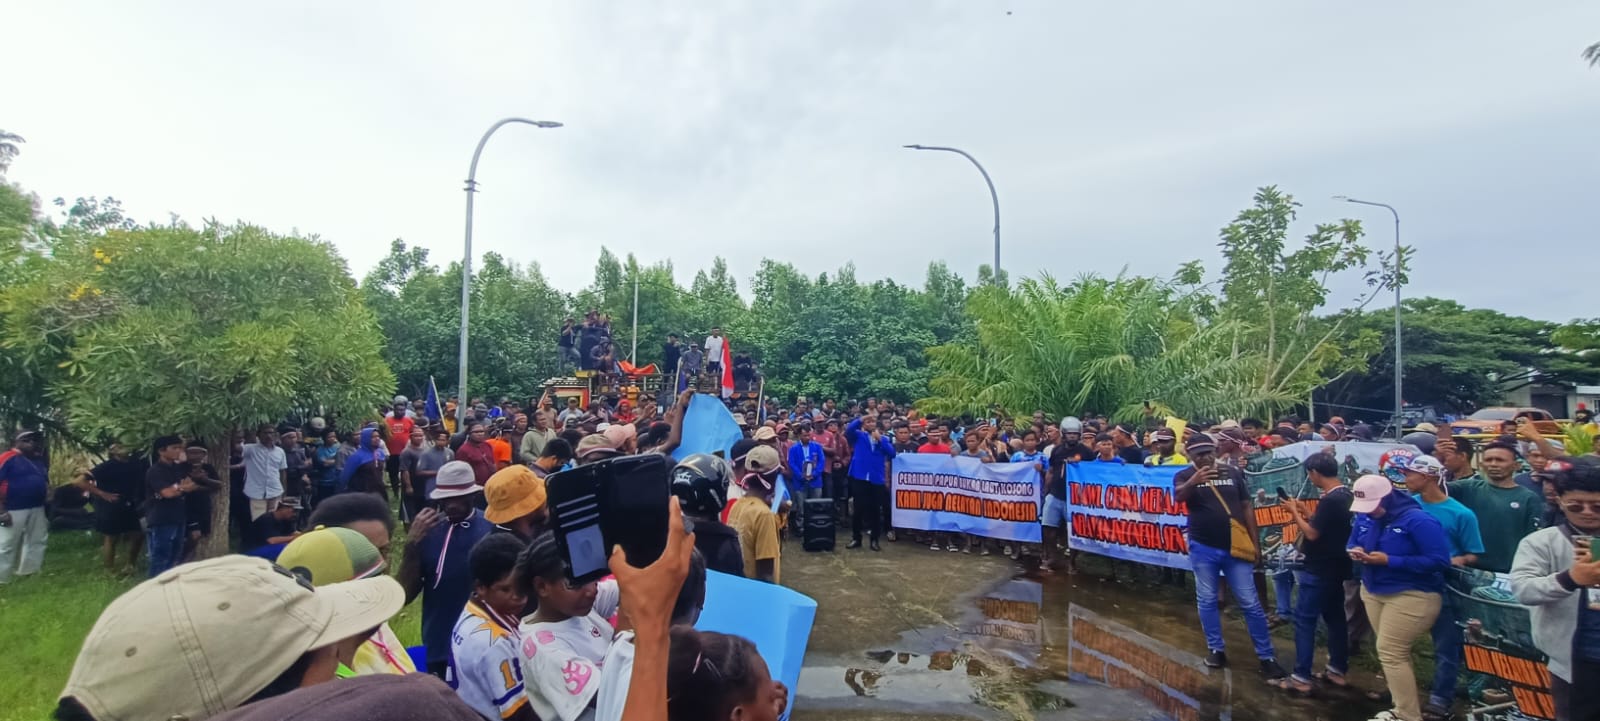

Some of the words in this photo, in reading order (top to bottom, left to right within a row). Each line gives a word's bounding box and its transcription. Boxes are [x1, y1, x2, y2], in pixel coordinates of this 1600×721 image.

[898, 471, 934, 486] PERAIRAN
[934, 473, 959, 488] PAPUA
[981, 479, 1000, 495] LAUT
[1000, 481, 1034, 497] KOSONG
[896, 489, 921, 510] KAMI
[921, 491, 945, 511] JUGA
[945, 492, 982, 517] NELAYAN
[983, 498, 1038, 523] INDONESIA
